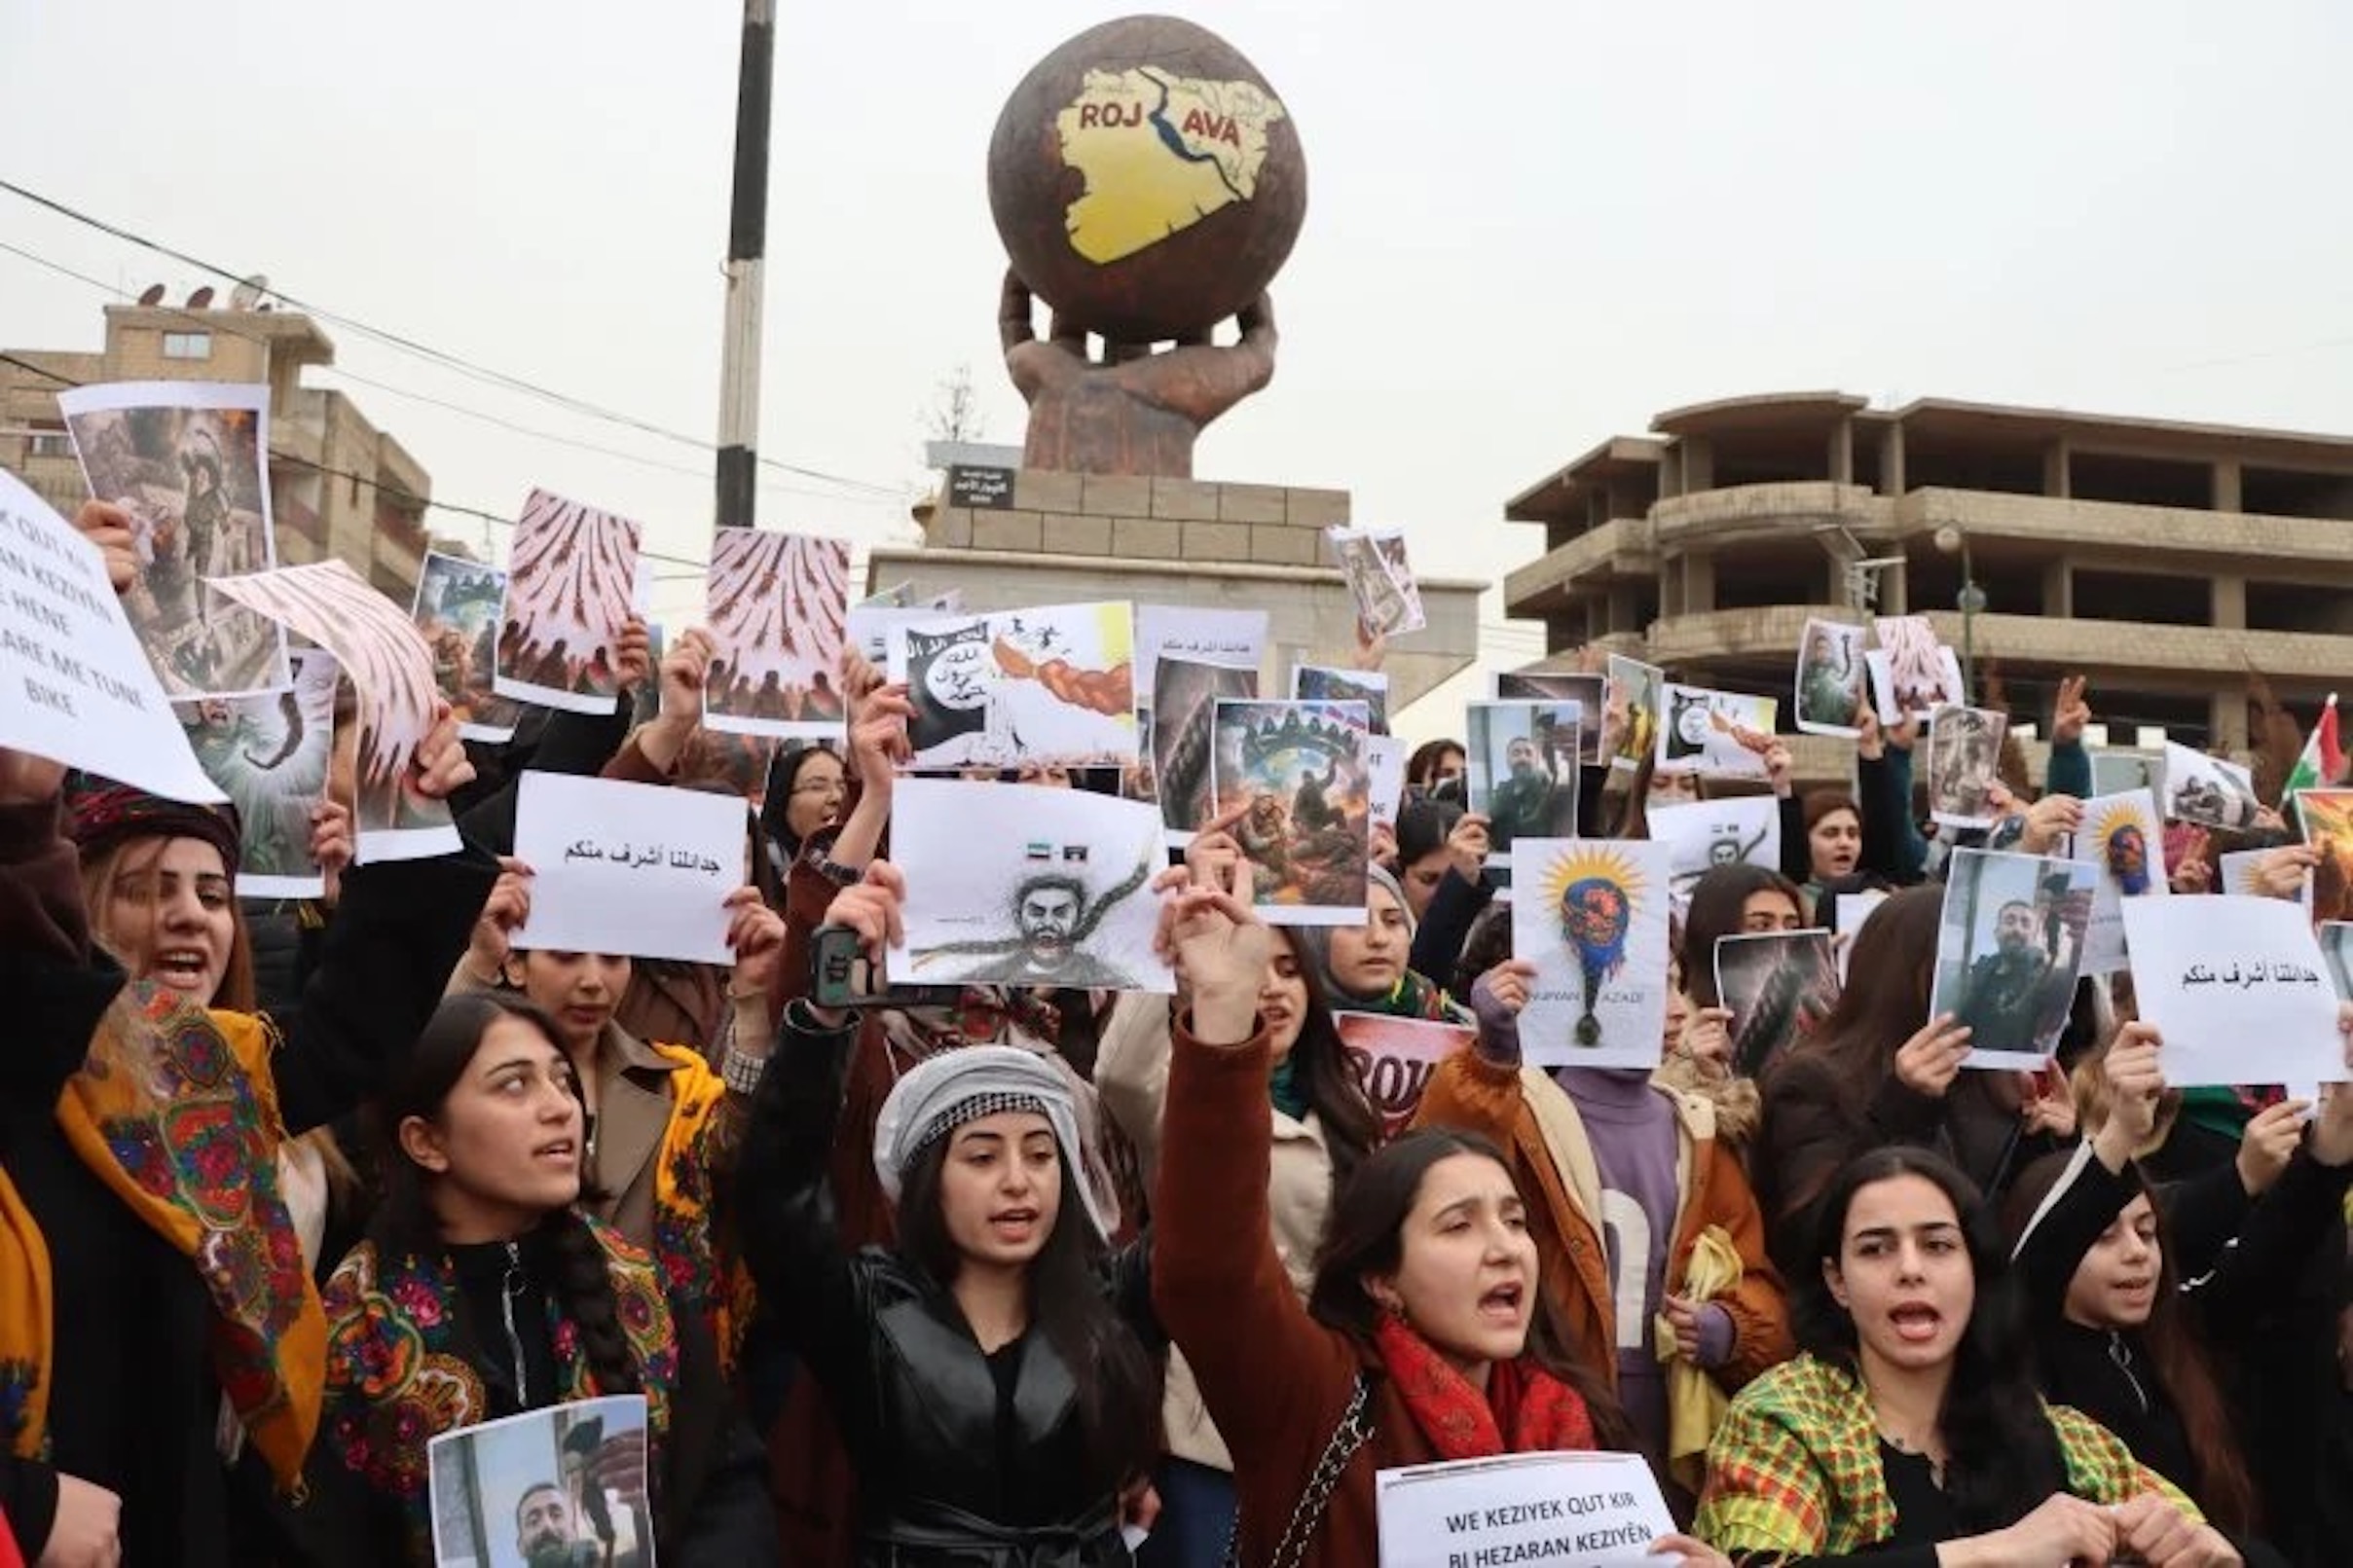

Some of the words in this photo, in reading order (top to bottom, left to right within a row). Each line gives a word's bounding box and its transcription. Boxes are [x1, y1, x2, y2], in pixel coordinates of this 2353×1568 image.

[1080, 102, 1141, 128] ROJ
[1182, 108, 1239, 148] AVA
[0, 628, 47, 667] ARE
[23, 675, 78, 718] BIKE
[565, 840, 604, 863] منكم
[2183, 964, 2216, 989] منكم
[1446, 1511, 1480, 1534] WE
[1485, 1499, 1563, 1528] KEZIYEK
[1567, 1494, 1604, 1517] QUT
[1608, 1492, 1638, 1509] KIR
[1476, 1536, 1570, 1567] HEZARAN
[1576, 1521, 1653, 1551] KEZIYÊN
